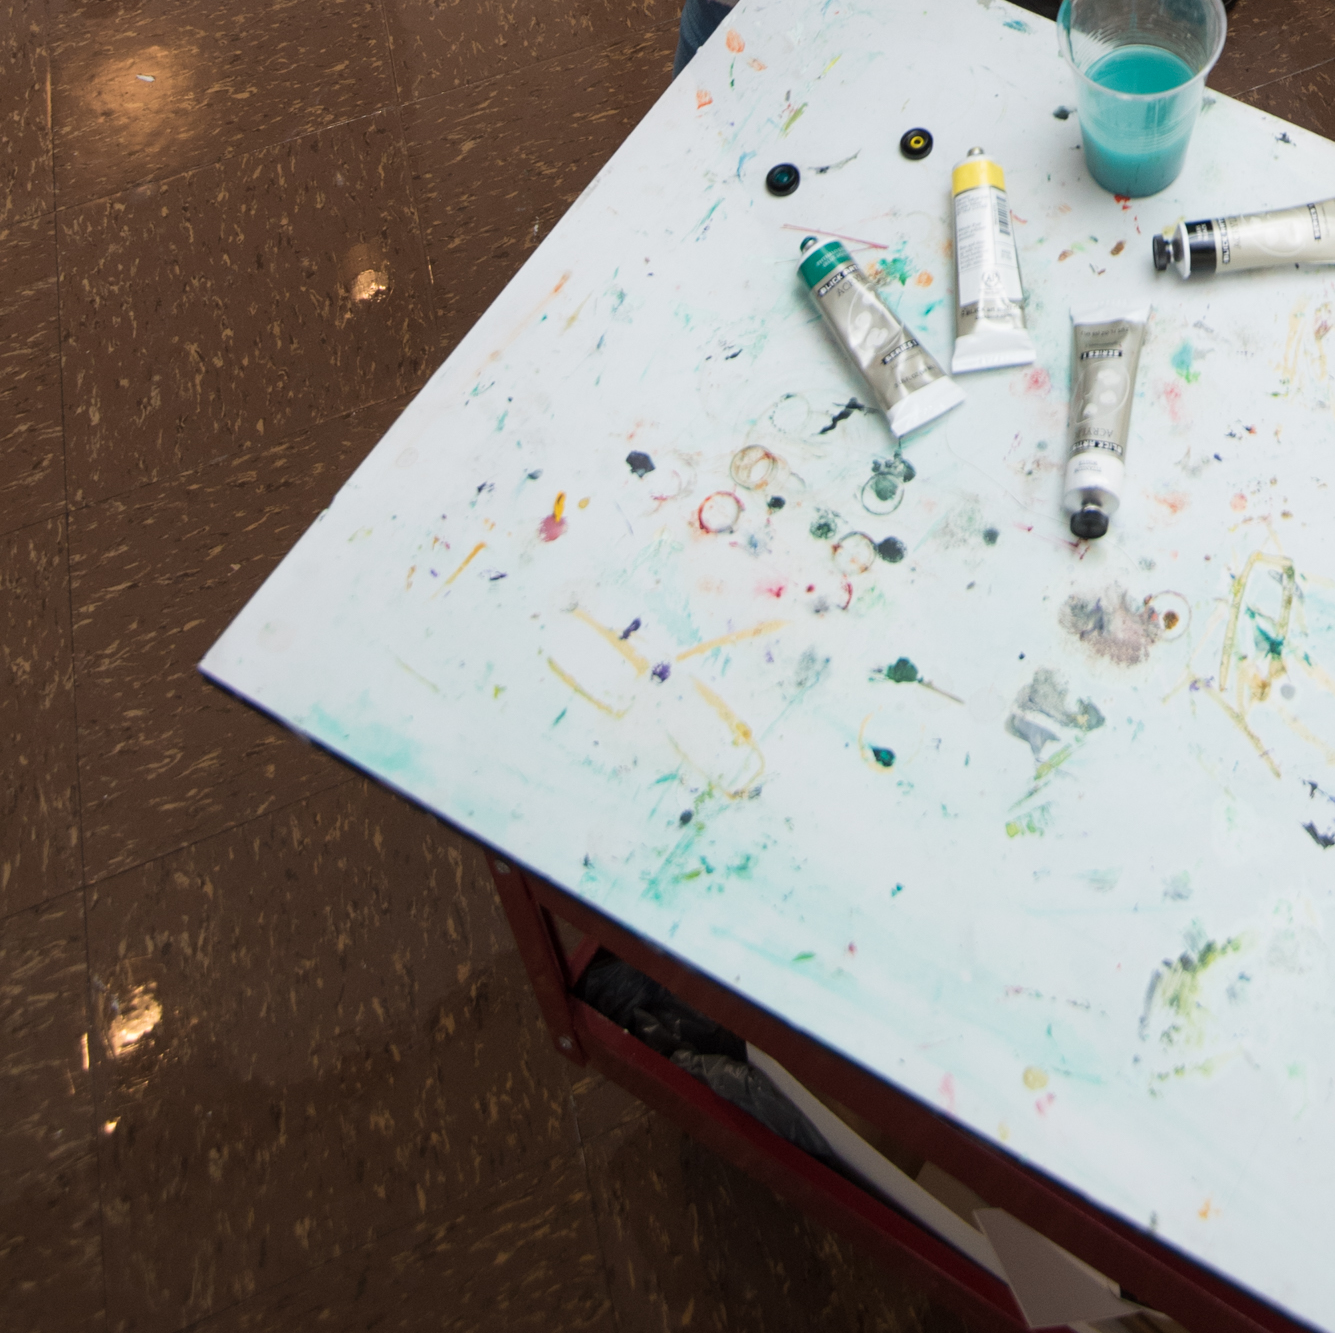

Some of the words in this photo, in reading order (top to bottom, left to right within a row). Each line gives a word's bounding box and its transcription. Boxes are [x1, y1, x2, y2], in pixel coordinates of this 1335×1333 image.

[1221, 235, 1229, 261] BLICK
[819, 272, 843, 296] BLICK
[842, 263, 859, 276] ART
[884, 340, 914, 362] SERIES
[1088, 349, 1119, 357] SERIES
[1098, 441, 1121, 453] BLICK
